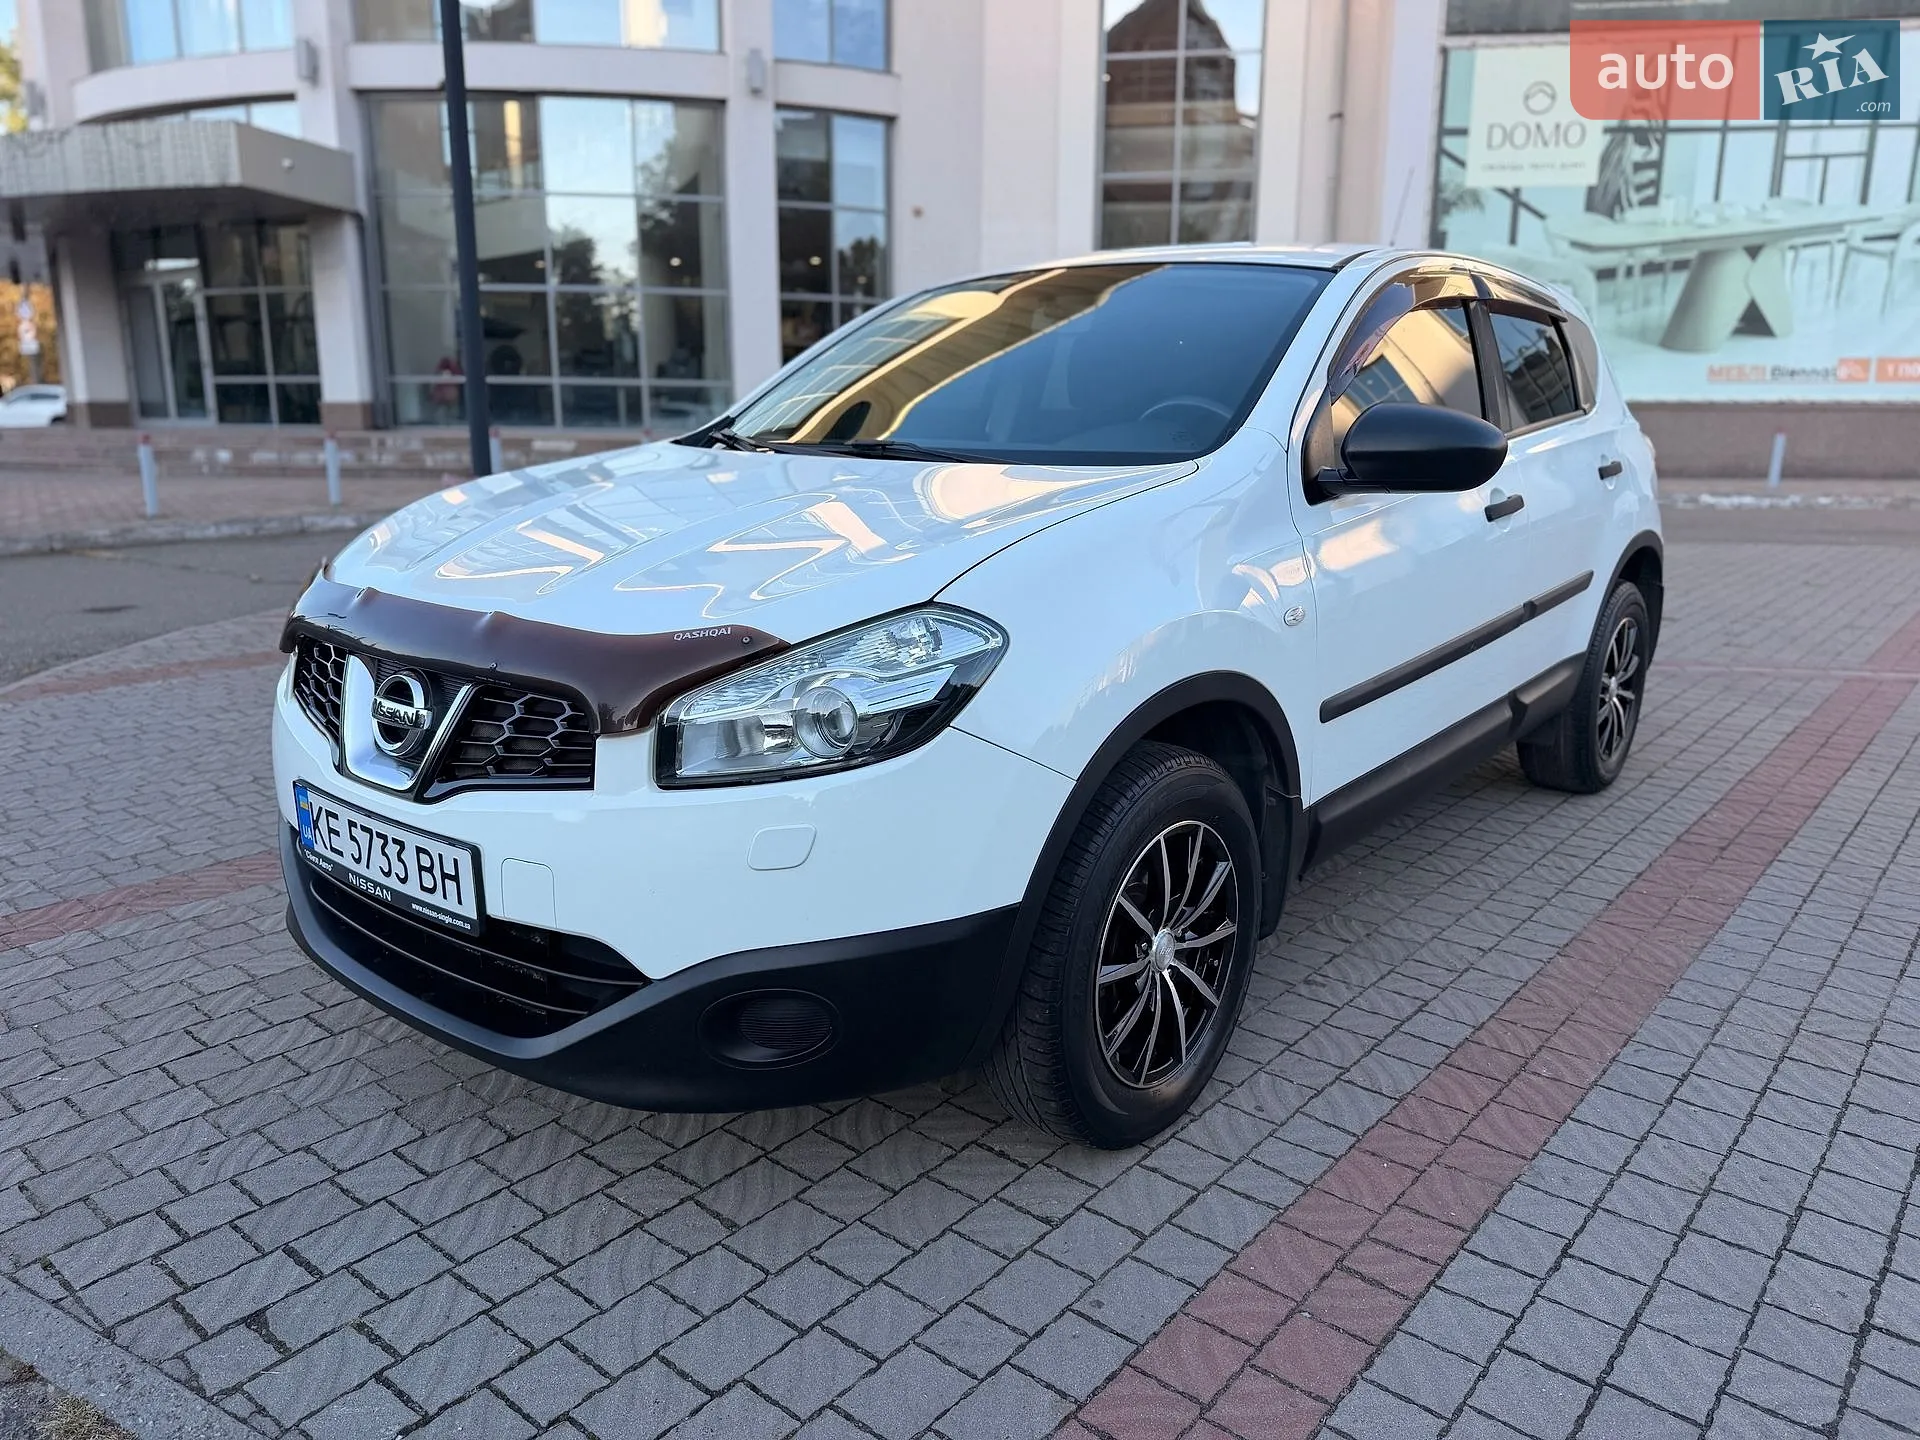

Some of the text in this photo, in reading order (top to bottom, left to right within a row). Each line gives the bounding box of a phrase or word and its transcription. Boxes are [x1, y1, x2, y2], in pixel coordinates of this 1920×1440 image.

[1486, 120, 1587, 151] DOMO
[673, 627, 732, 640] QASHQAI
[303, 825, 313, 841] UA
[310, 801, 463, 905] KE 5733 BH
[348, 872, 392, 901] NISSAN
